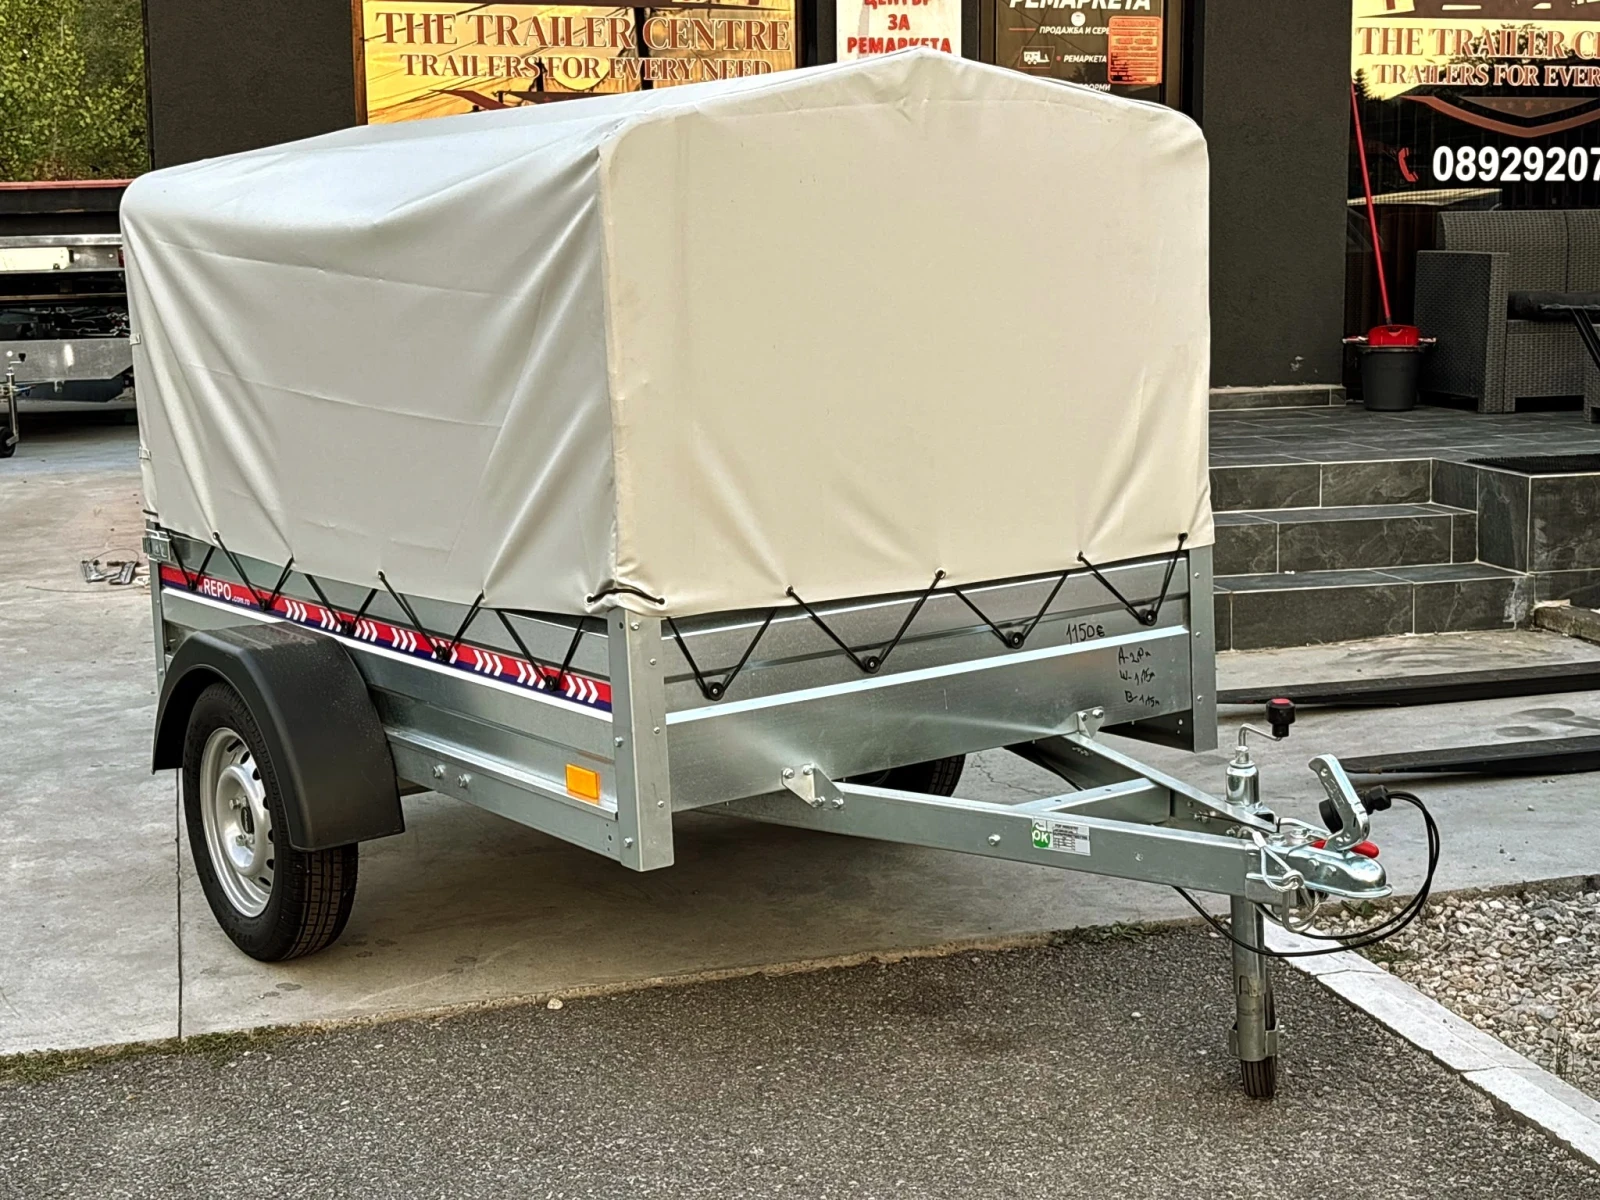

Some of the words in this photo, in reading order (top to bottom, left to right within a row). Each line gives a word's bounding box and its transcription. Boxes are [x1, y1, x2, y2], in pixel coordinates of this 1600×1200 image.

[375, 12, 459, 45] THE
[465, 14, 635, 49] TRAILER
[642, 17, 791, 51] CENTRE
[887, 13, 911, 31] ЗА
[1039, 25, 1084, 35] ПРОДАЖБА
[1084, 26, 1092, 35] И
[1358, 27, 1424, 57] THE
[1430, 28, 1568, 59] TRAILER
[399, 53, 541, 79] TRAILERS
[546, 56, 601, 80] FOR
[607, 57, 697, 82] EVERY
[1063, 54, 1107, 63] РЕМАРКЕТА
[1374, 64, 1489, 87] TRAILERS
[1493, 65, 1540, 87] FOR
[203, 579, 231, 600] REPO
[1066, 622, 1106, 645] 1150€
[1032, 829, 1050, 844] OK
